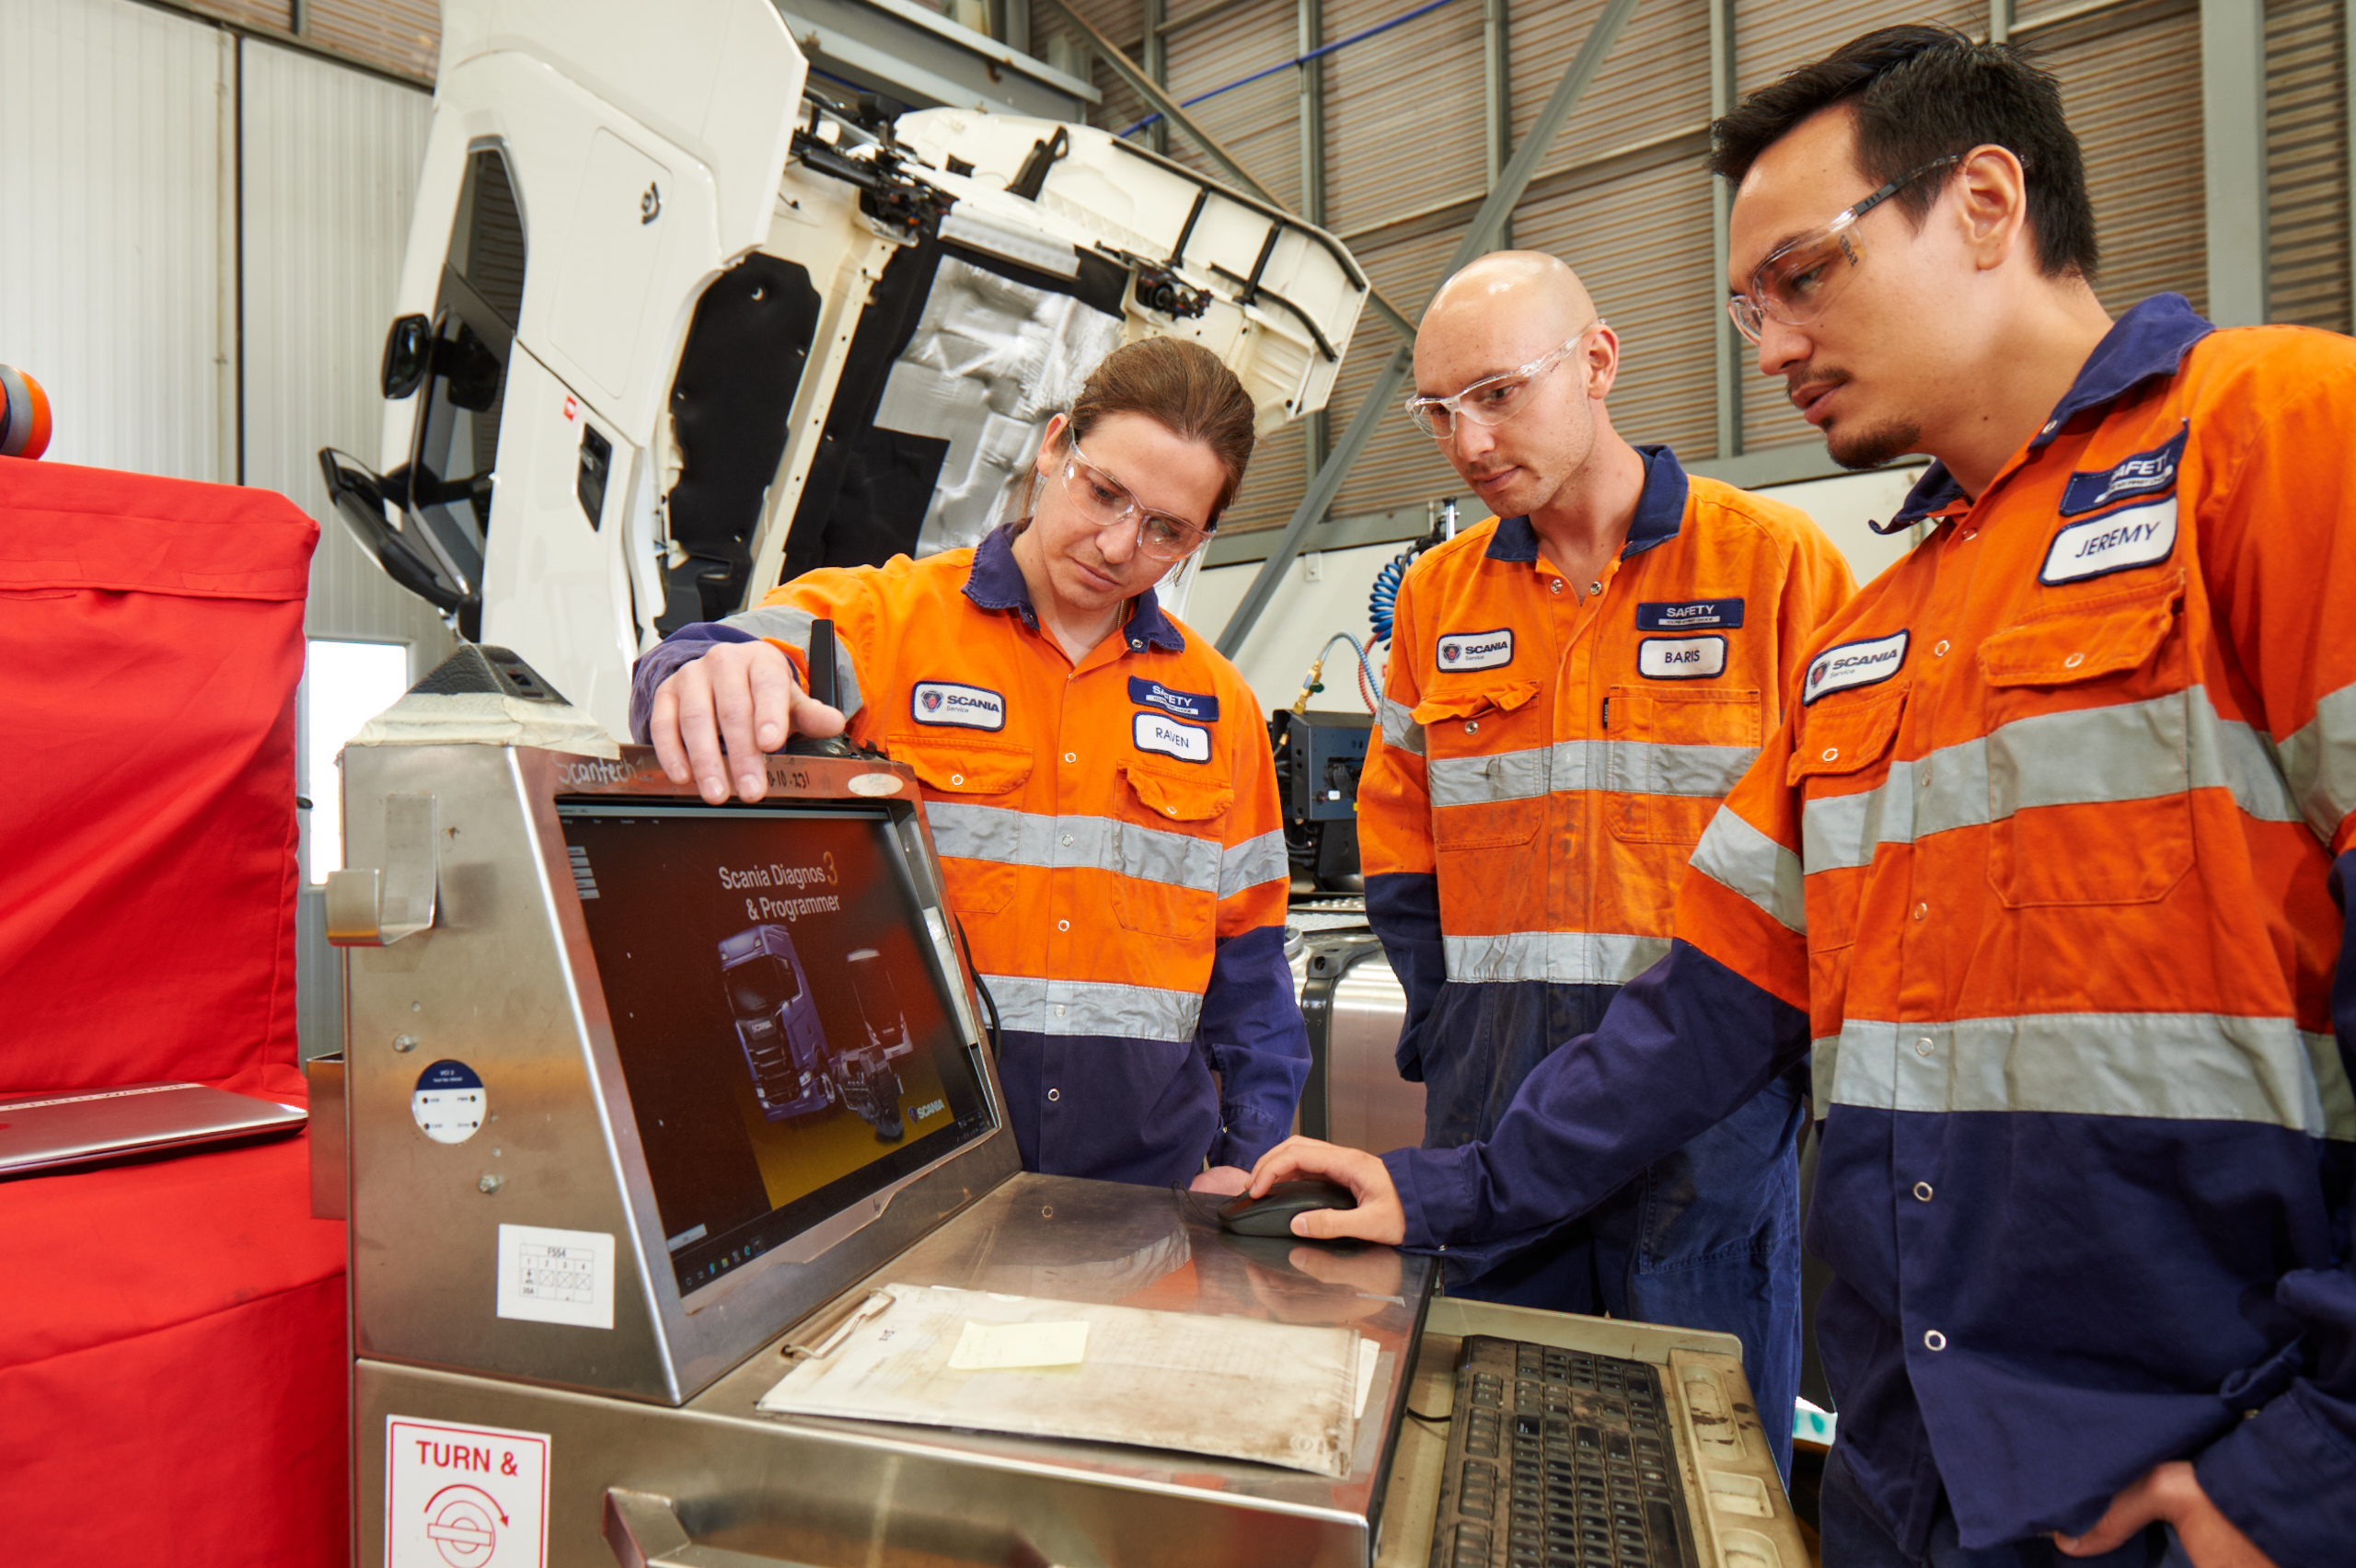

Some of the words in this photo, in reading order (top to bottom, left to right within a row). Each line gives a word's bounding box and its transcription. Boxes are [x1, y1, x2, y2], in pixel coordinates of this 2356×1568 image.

[2075, 521, 2161, 559] JEREMY
[1666, 604, 1715, 618] SAFETY
[1465, 640, 1508, 654] SCANIA
[1664, 650, 1701, 663] BARIS
[1832, 649, 1898, 670] SCANIA
[1829, 669, 1855, 679] Service
[946, 705, 969, 713] Service
[947, 695, 1000, 713] SCANIA
[1155, 727, 1189, 749] RAVEN
[719, 864, 771, 890] Scania
[770, 863, 826, 890] Diagnos
[823, 851, 838, 886] 3
[745, 897, 761, 921] &
[758, 894, 841, 922] Programmer
[917, 1099, 944, 1120] SCANIA
[415, 1440, 491, 1473] TURN
[500, 1451, 518, 1477] &
